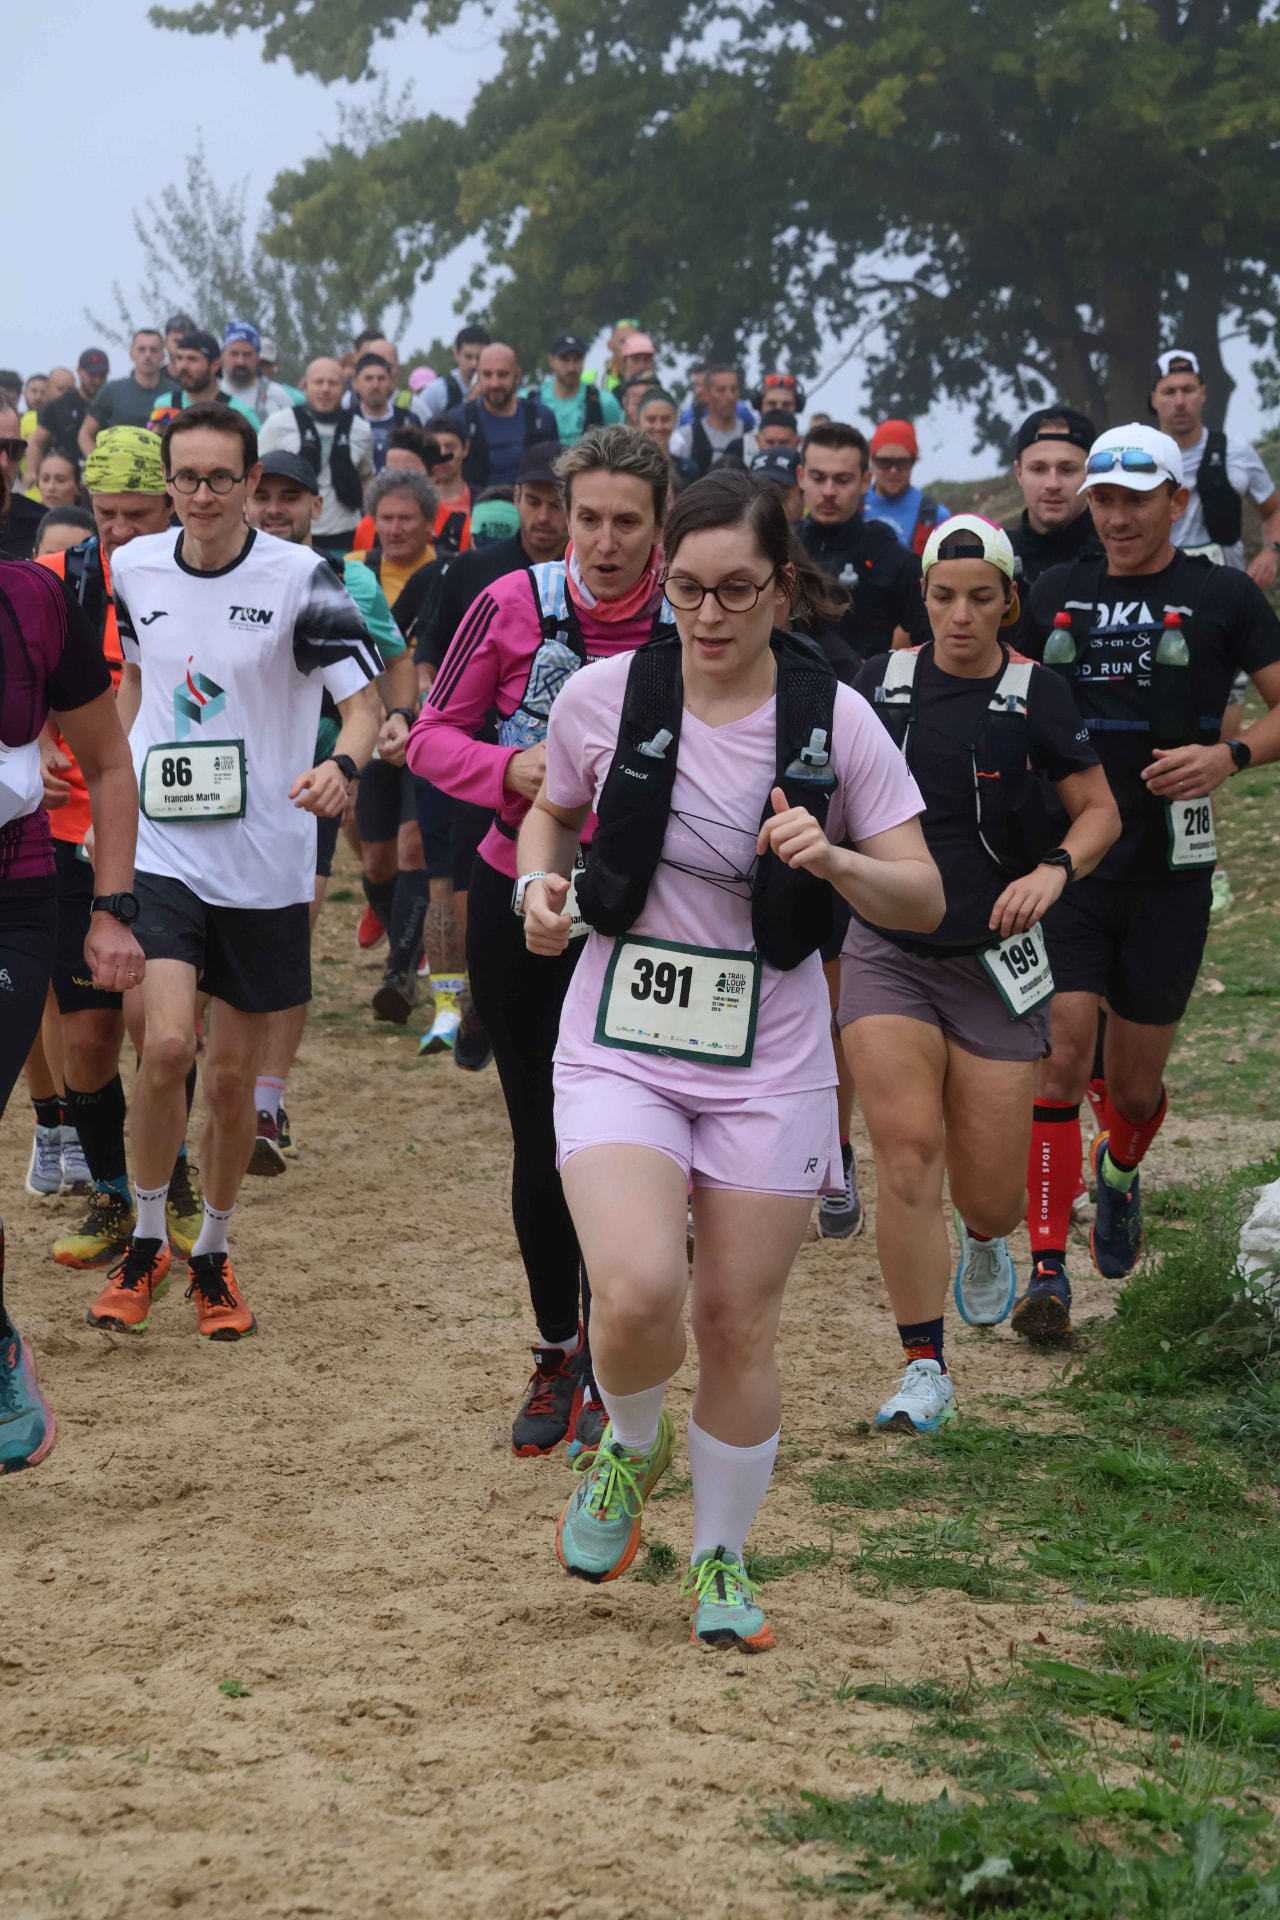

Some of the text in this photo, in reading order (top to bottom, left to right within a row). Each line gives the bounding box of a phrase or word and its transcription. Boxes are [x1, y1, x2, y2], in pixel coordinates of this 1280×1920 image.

[1101, 662, 1133, 675] RUN
[161, 757, 193, 788] 86
[196, 792, 221, 802] Martin
[1183, 805, 1210, 836] 218
[999, 936, 1039, 980] 199
[630, 957, 694, 1009] 391
[725, 985, 746, 995] VERT
[726, 979, 747, 988] LOUP
